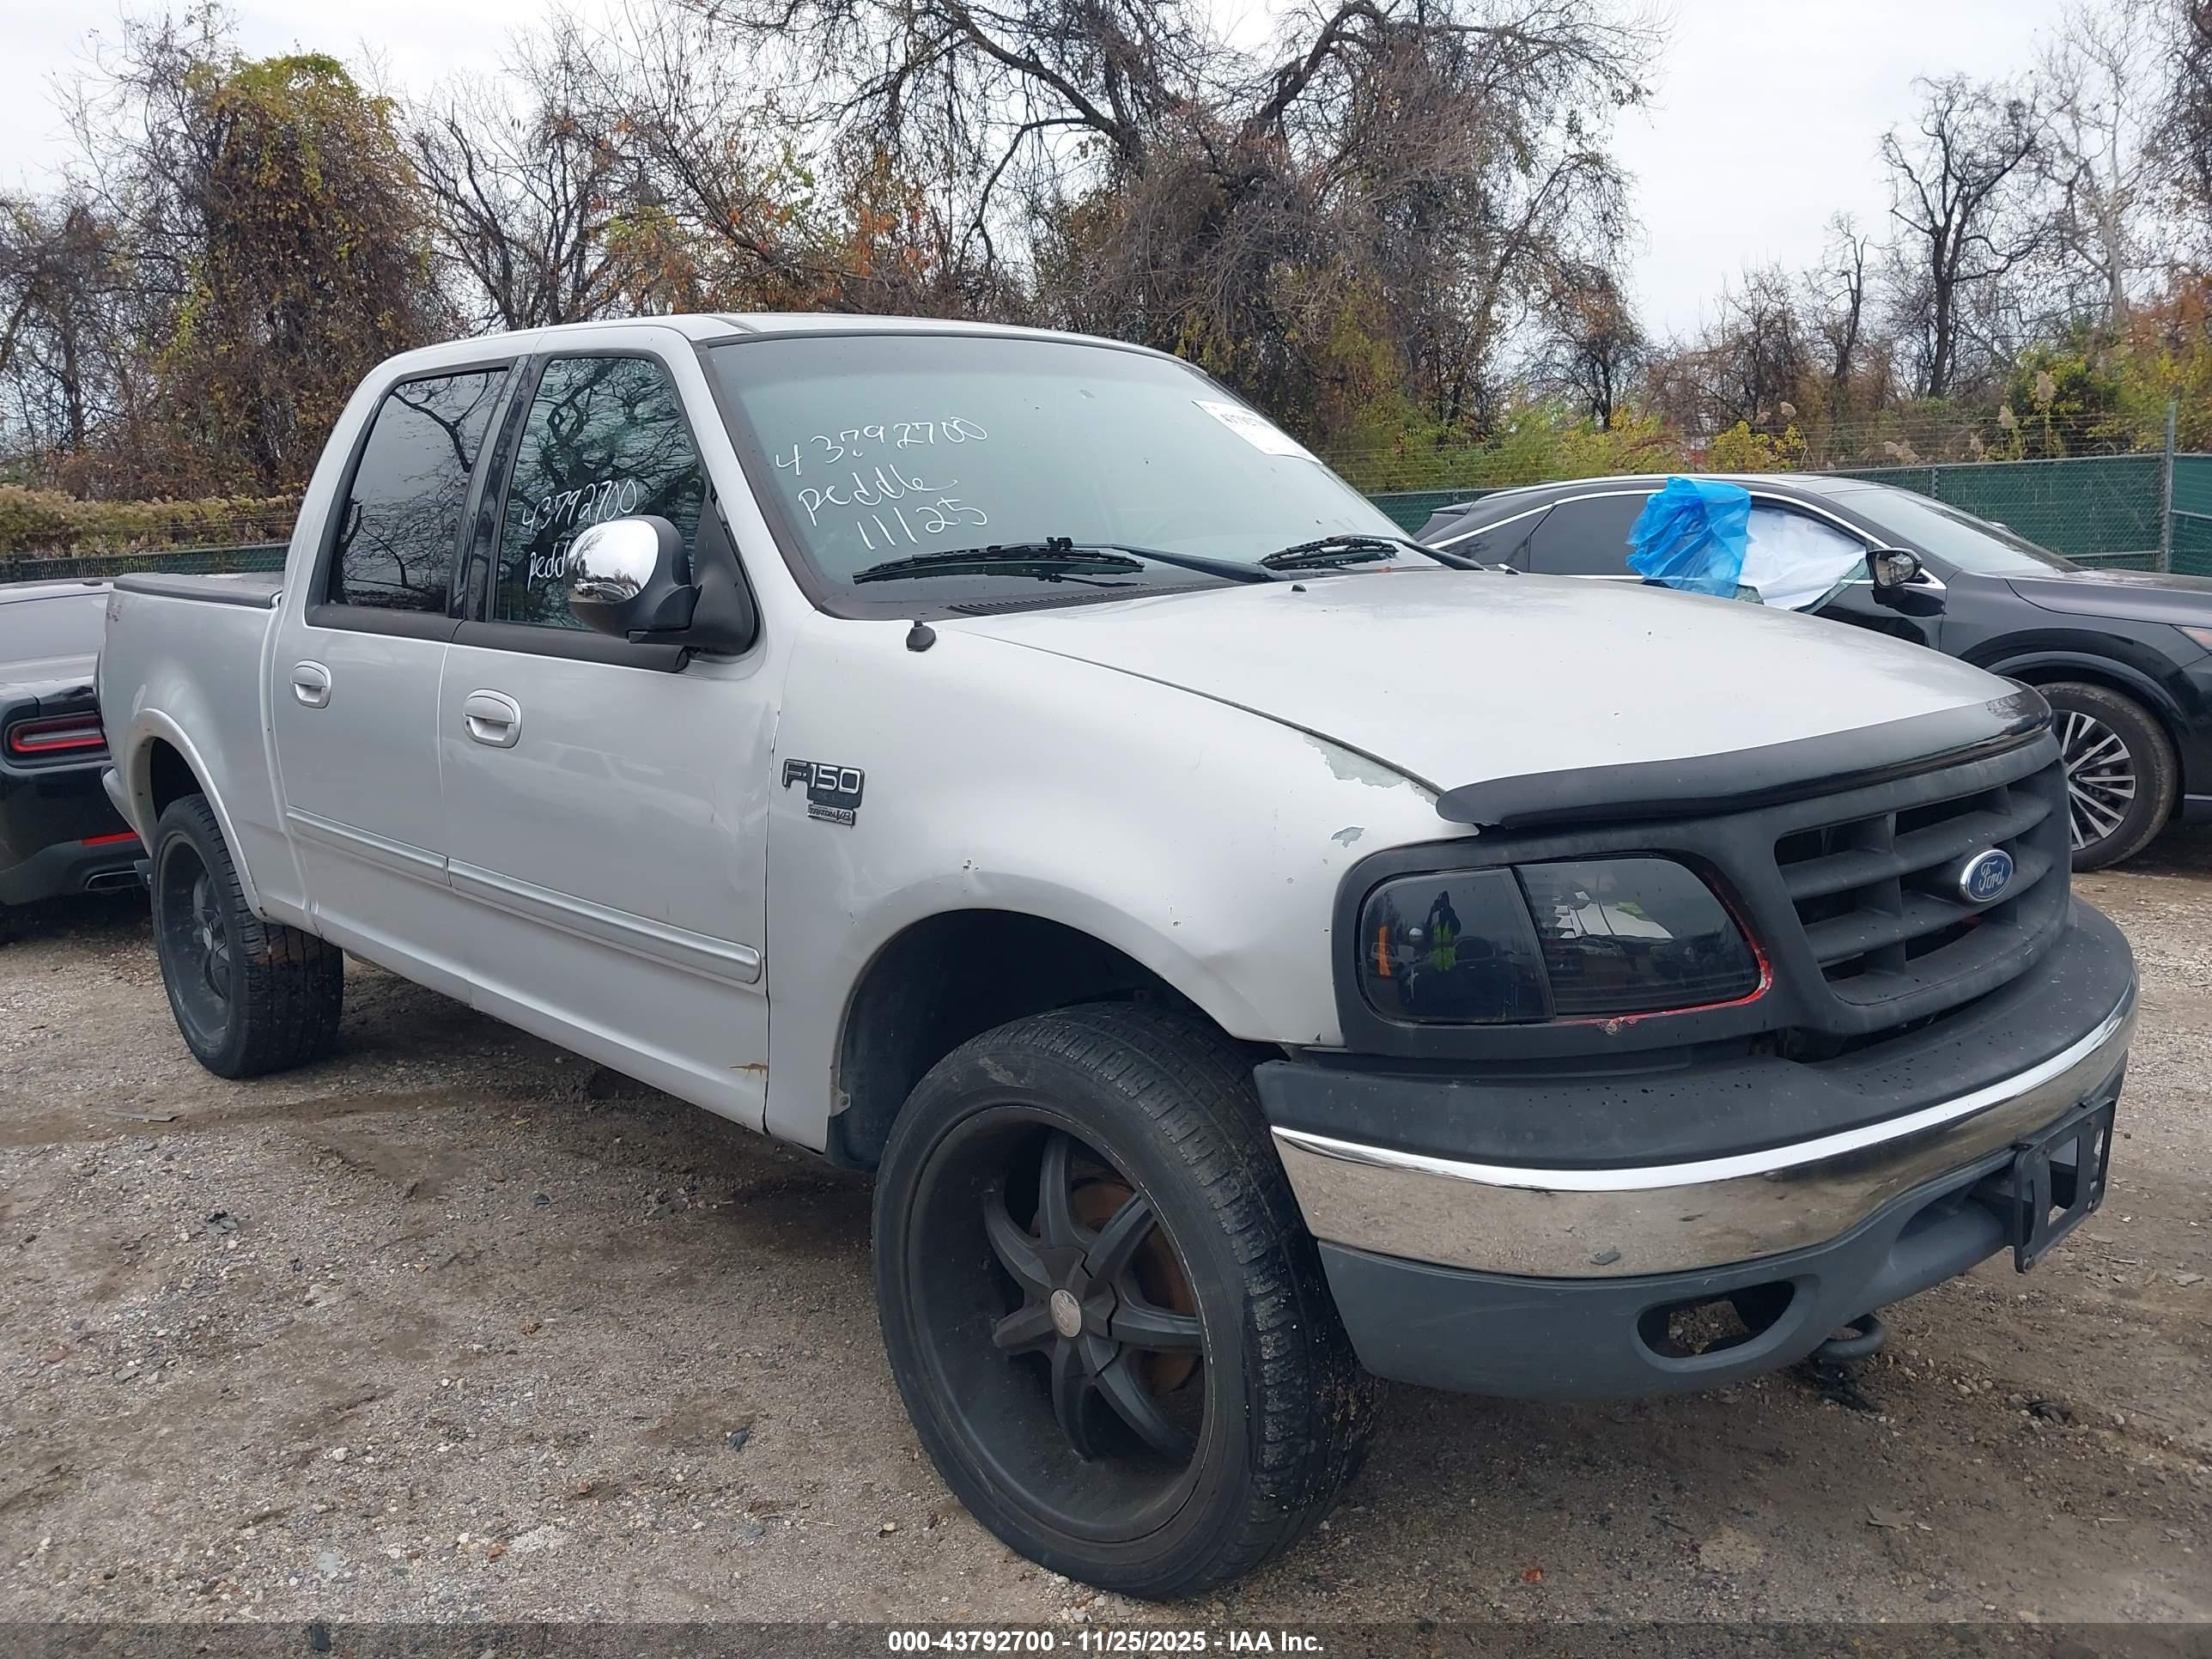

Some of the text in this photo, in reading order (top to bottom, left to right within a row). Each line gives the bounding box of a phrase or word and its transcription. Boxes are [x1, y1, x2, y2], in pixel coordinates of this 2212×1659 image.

[775, 416, 988, 476] 43792700
[521, 478, 637, 534] 43792700
[798, 464, 957, 526] peddle
[526, 539, 570, 592] pedd
[1978, 860, 2005, 893] Ford
